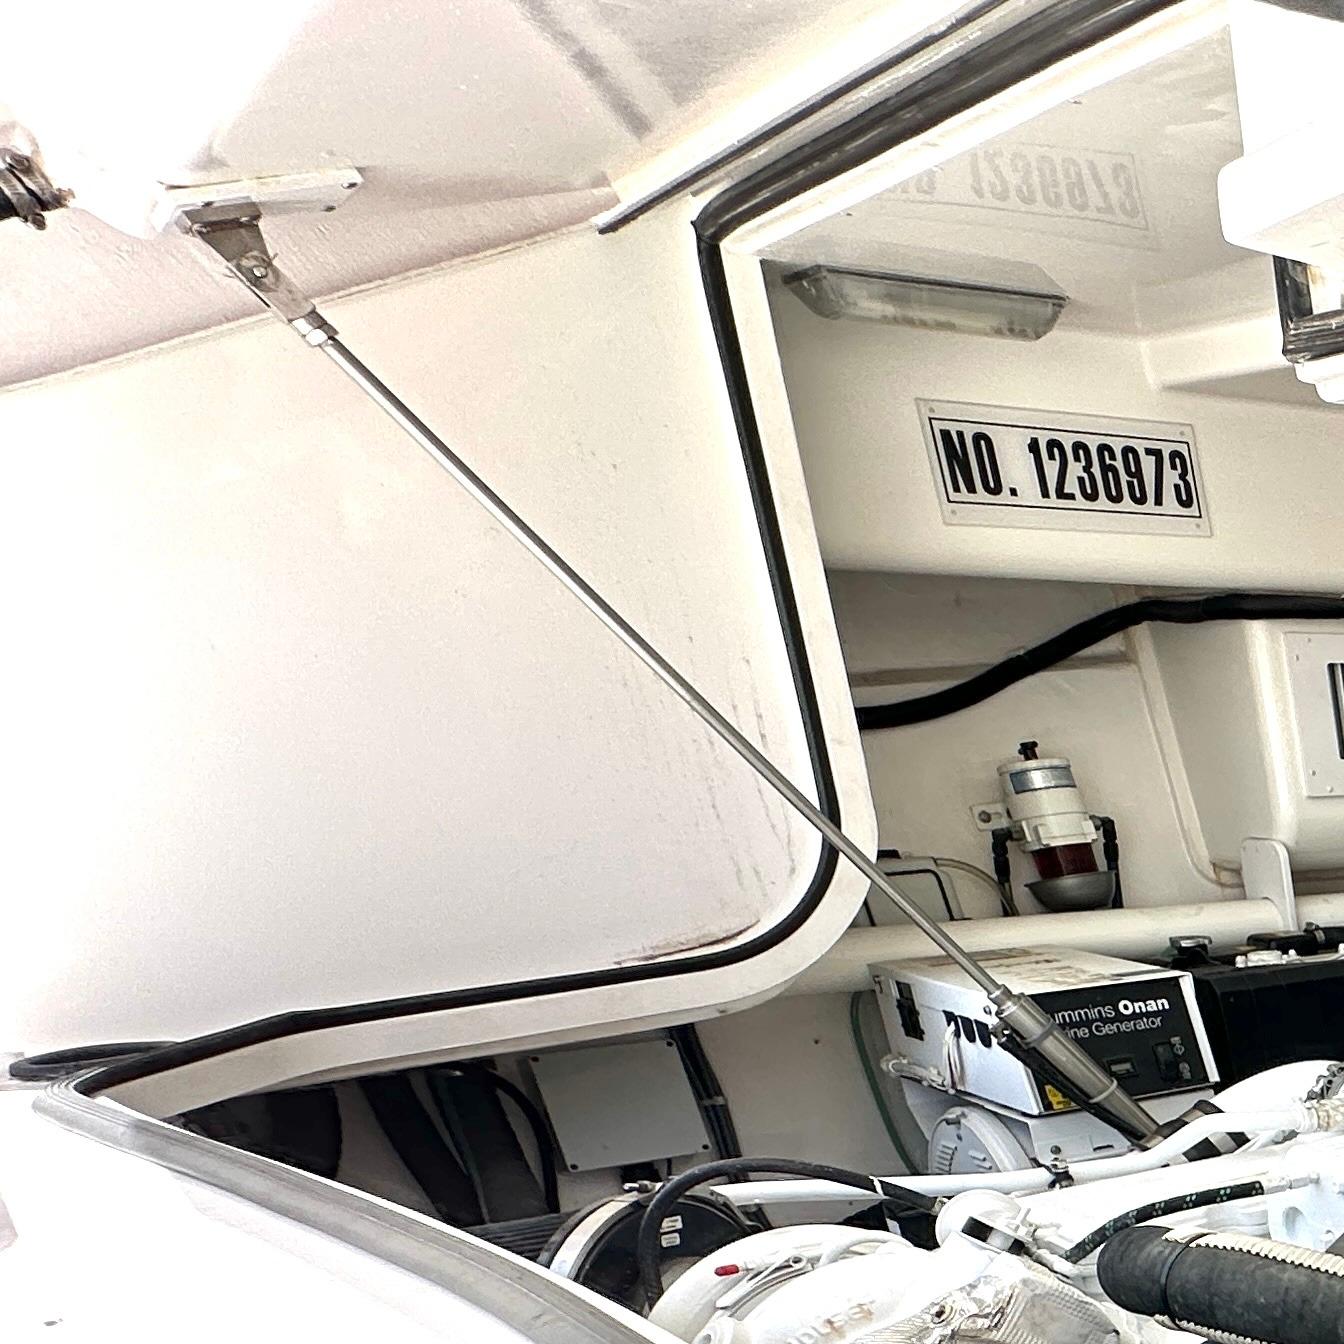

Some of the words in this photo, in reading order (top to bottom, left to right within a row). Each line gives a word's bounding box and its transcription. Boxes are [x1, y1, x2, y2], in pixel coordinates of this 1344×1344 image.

[938, 428, 1018, 496] NO.
[1027, 436, 1194, 508] 1236973
[1052, 1003, 1116, 1024] ummins
[1118, 997, 1170, 1015] Onan
[1091, 1015, 1163, 1036] Generator
